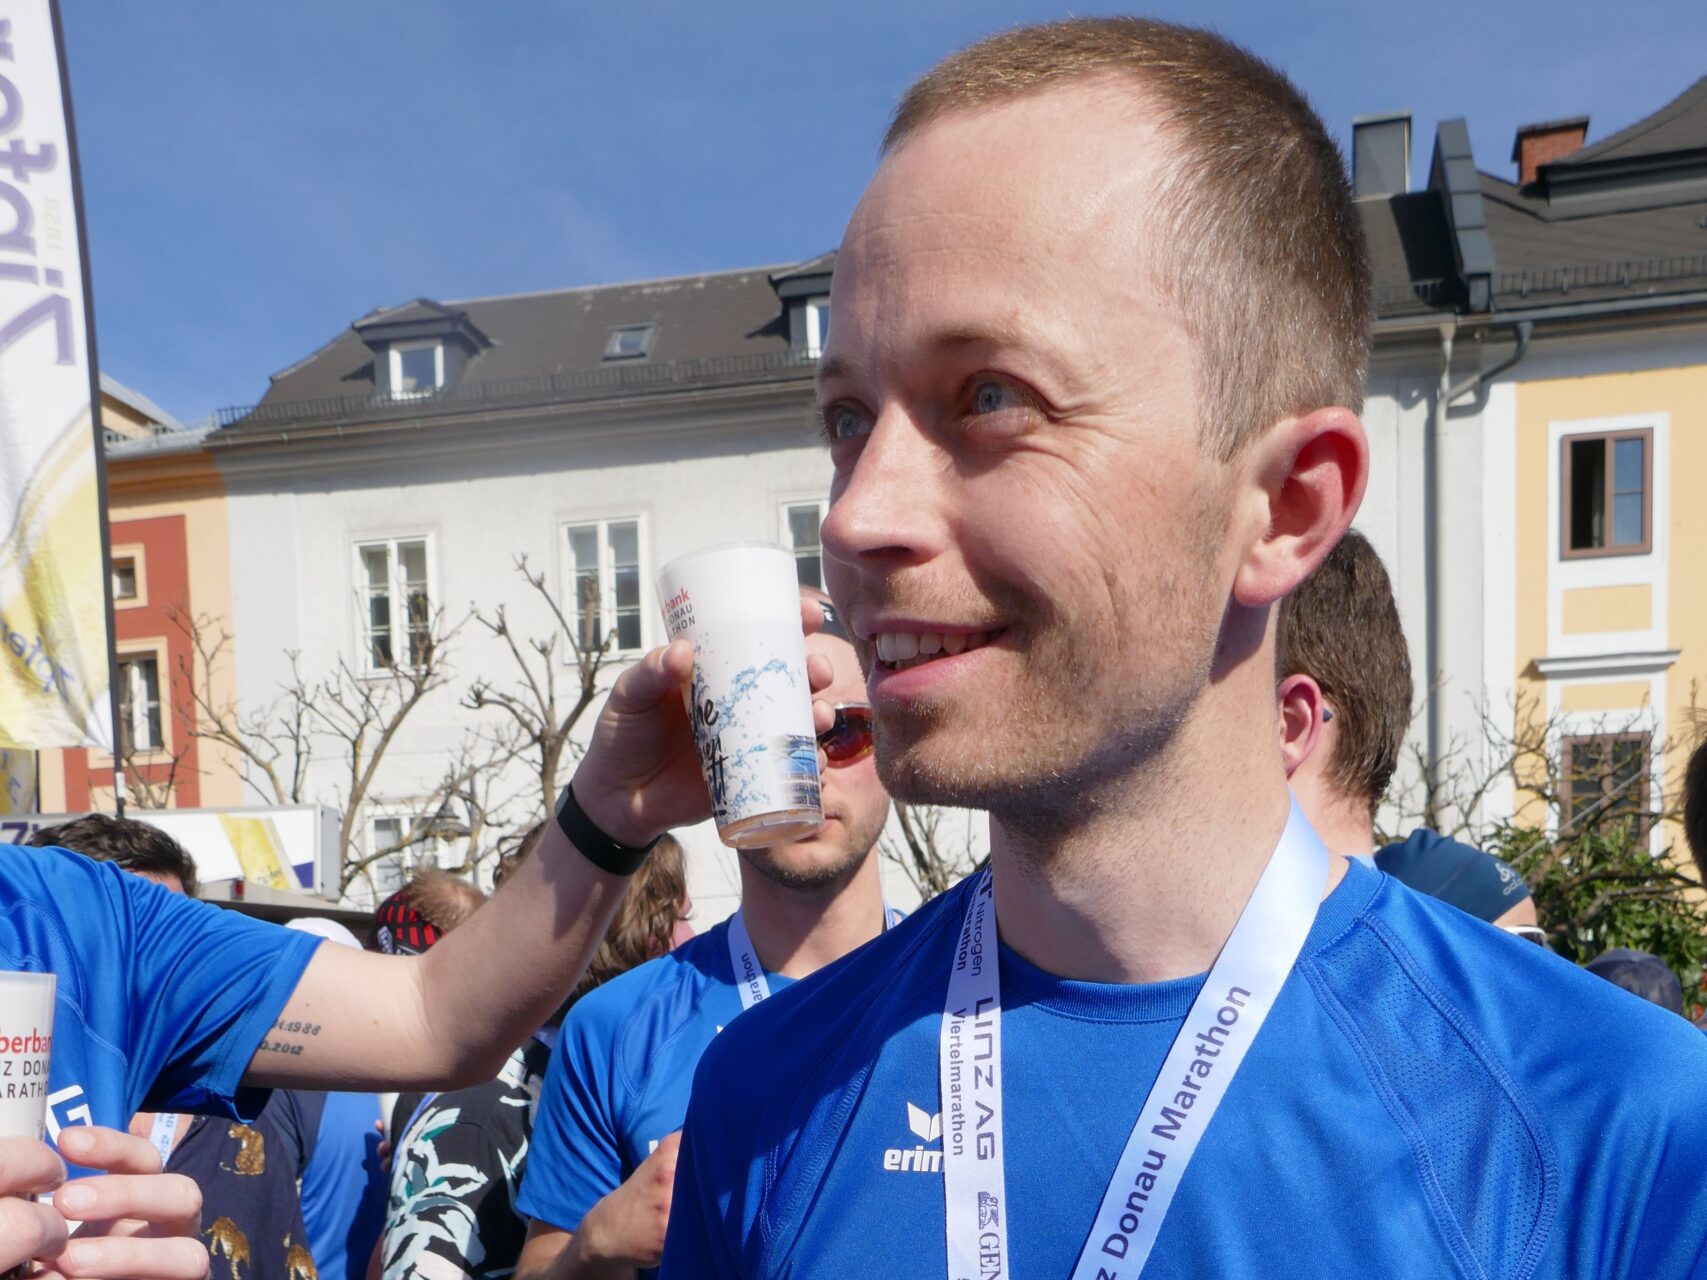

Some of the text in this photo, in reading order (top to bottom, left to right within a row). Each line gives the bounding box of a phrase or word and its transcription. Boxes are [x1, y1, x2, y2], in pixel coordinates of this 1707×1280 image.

[971, 901, 985, 976] Nitrogen
[949, 1007, 967, 1156] Viertelmarathon
[974, 996, 995, 1161] LINZ AG
[1101, 1150, 1167, 1261] Donau
[1151, 984, 1252, 1142] Marathon
[883, 1145, 944, 1173] erim
